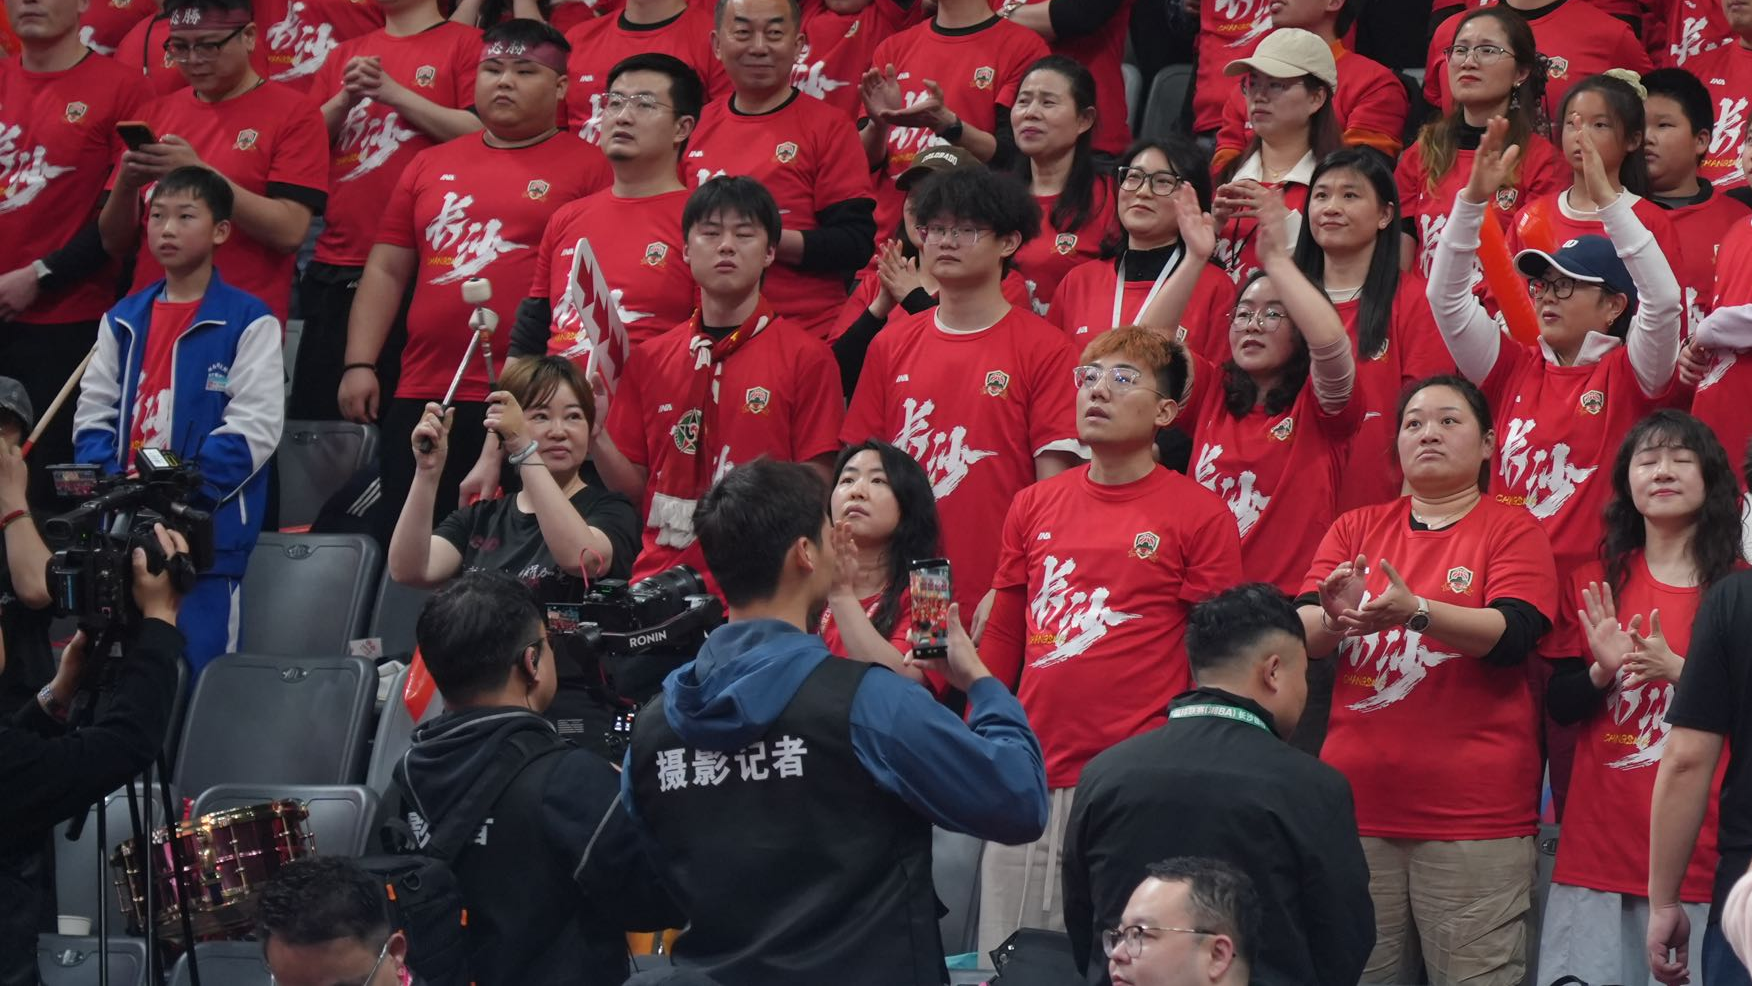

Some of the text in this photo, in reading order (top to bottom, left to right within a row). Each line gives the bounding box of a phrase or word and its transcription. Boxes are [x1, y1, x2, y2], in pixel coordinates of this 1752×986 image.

[267, 0, 340, 81] 长沙
[425, 191, 530, 285] 长沙
[892, 386, 997, 501] 长沙
[1497, 417, 1598, 520] 长沙
[629, 630, 667, 647] RONIN
[1032, 554, 1142, 670] 长沙
[656, 735, 808, 792] 摄影记者
